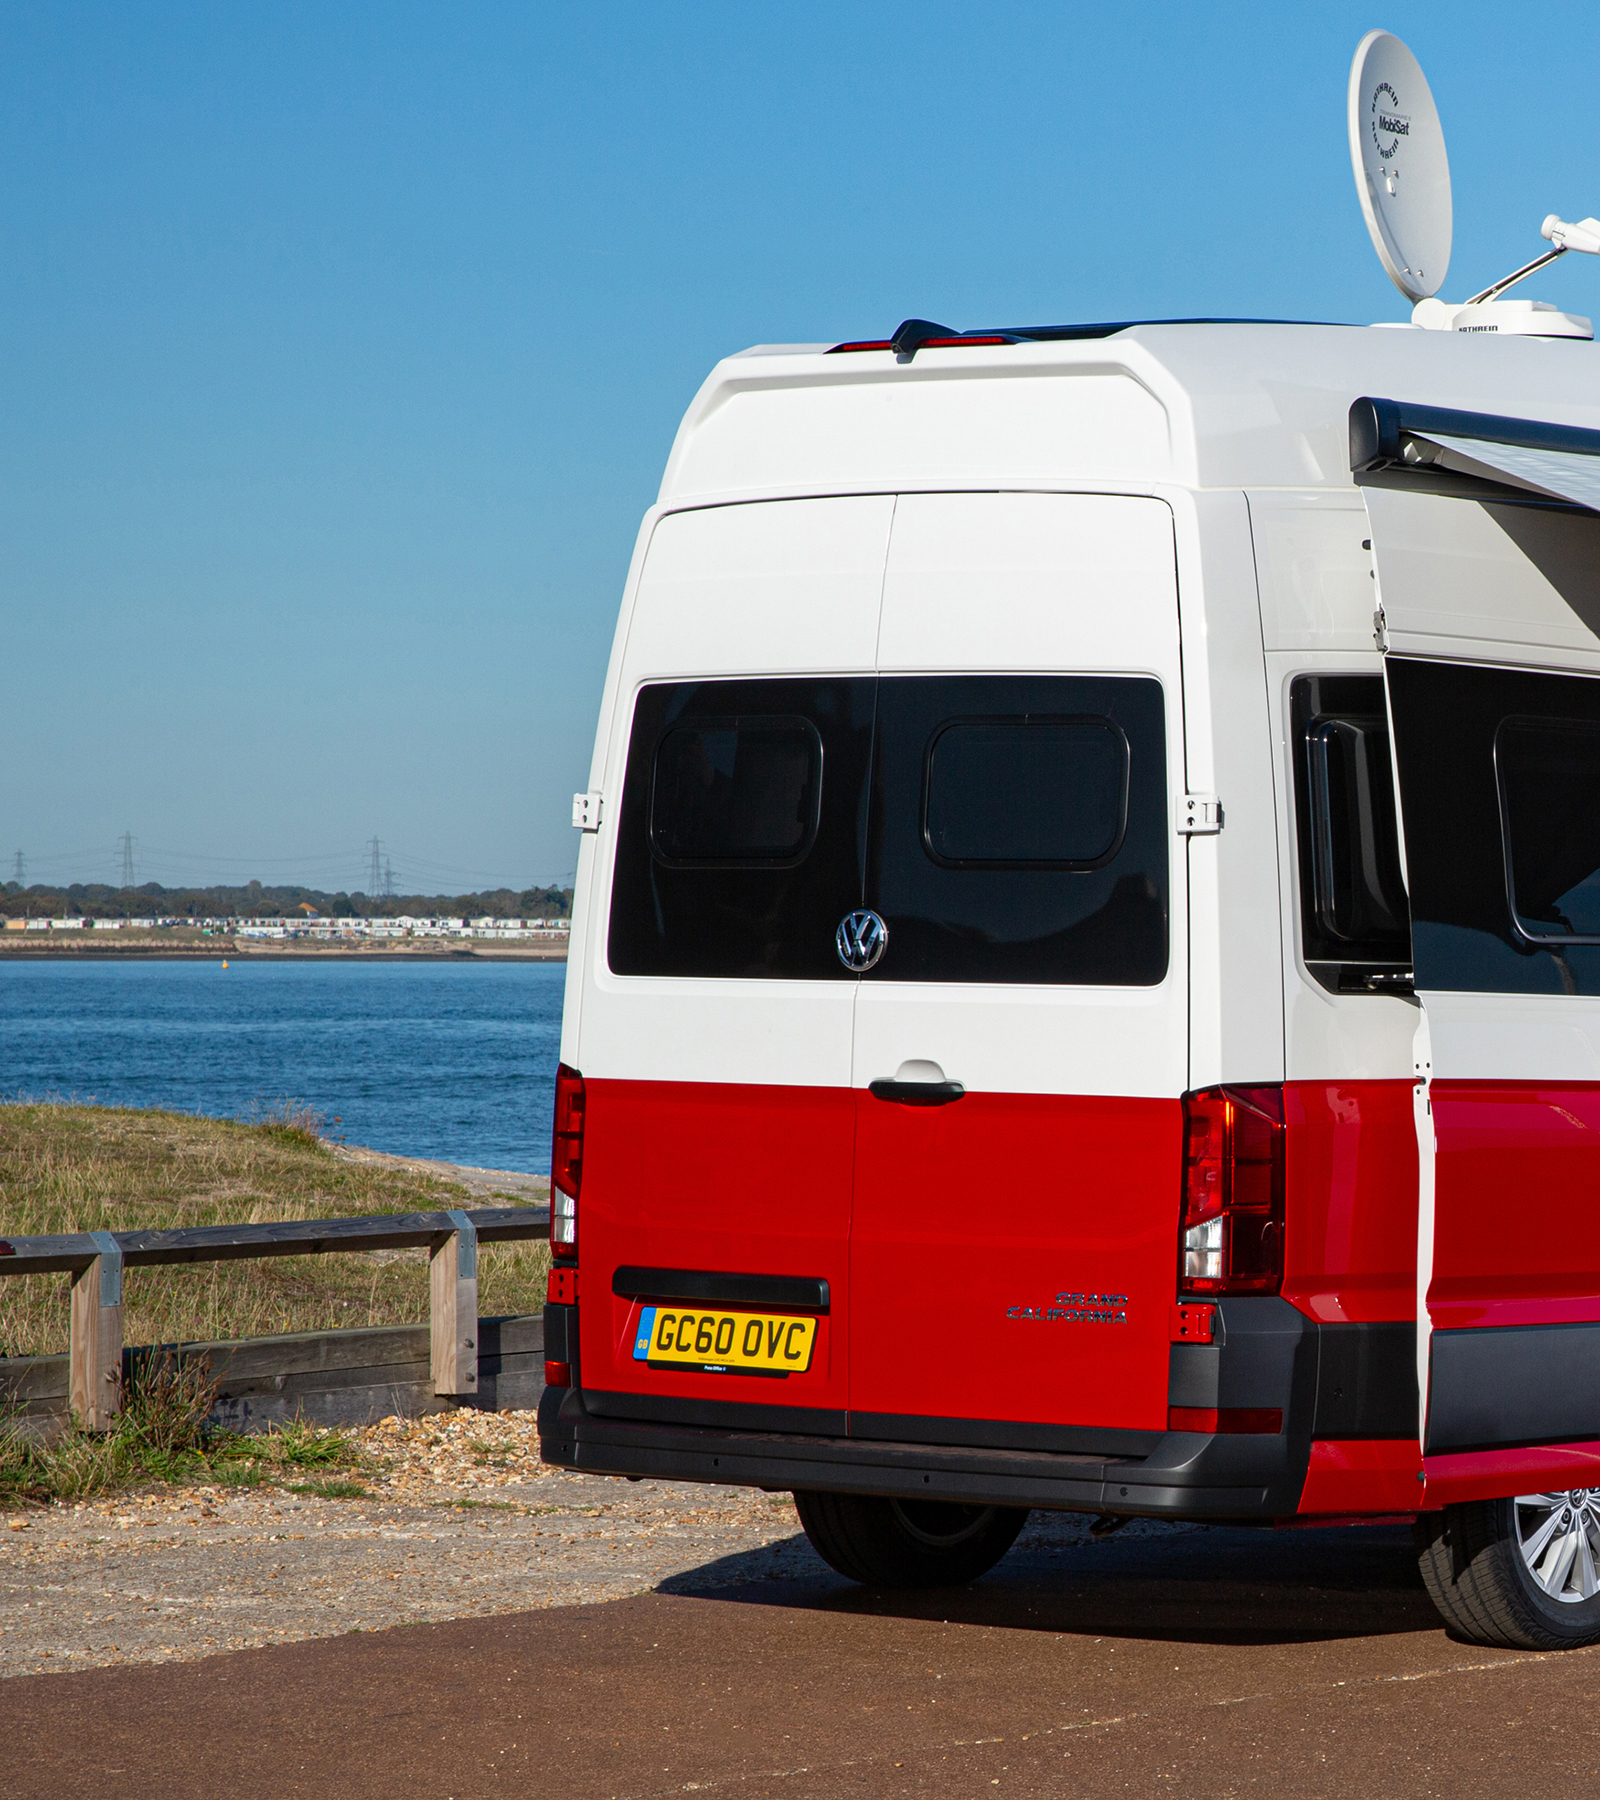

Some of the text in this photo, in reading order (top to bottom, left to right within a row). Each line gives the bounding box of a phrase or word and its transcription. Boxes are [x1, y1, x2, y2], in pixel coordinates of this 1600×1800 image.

[1379, 115, 1409, 136] MobiSat
[1055, 1291, 1129, 1307] GRAND
[1006, 1306, 1128, 1325] CALIFORNIA
[637, 1338, 649, 1350] GB
[656, 1313, 806, 1361] GC60 OVC
